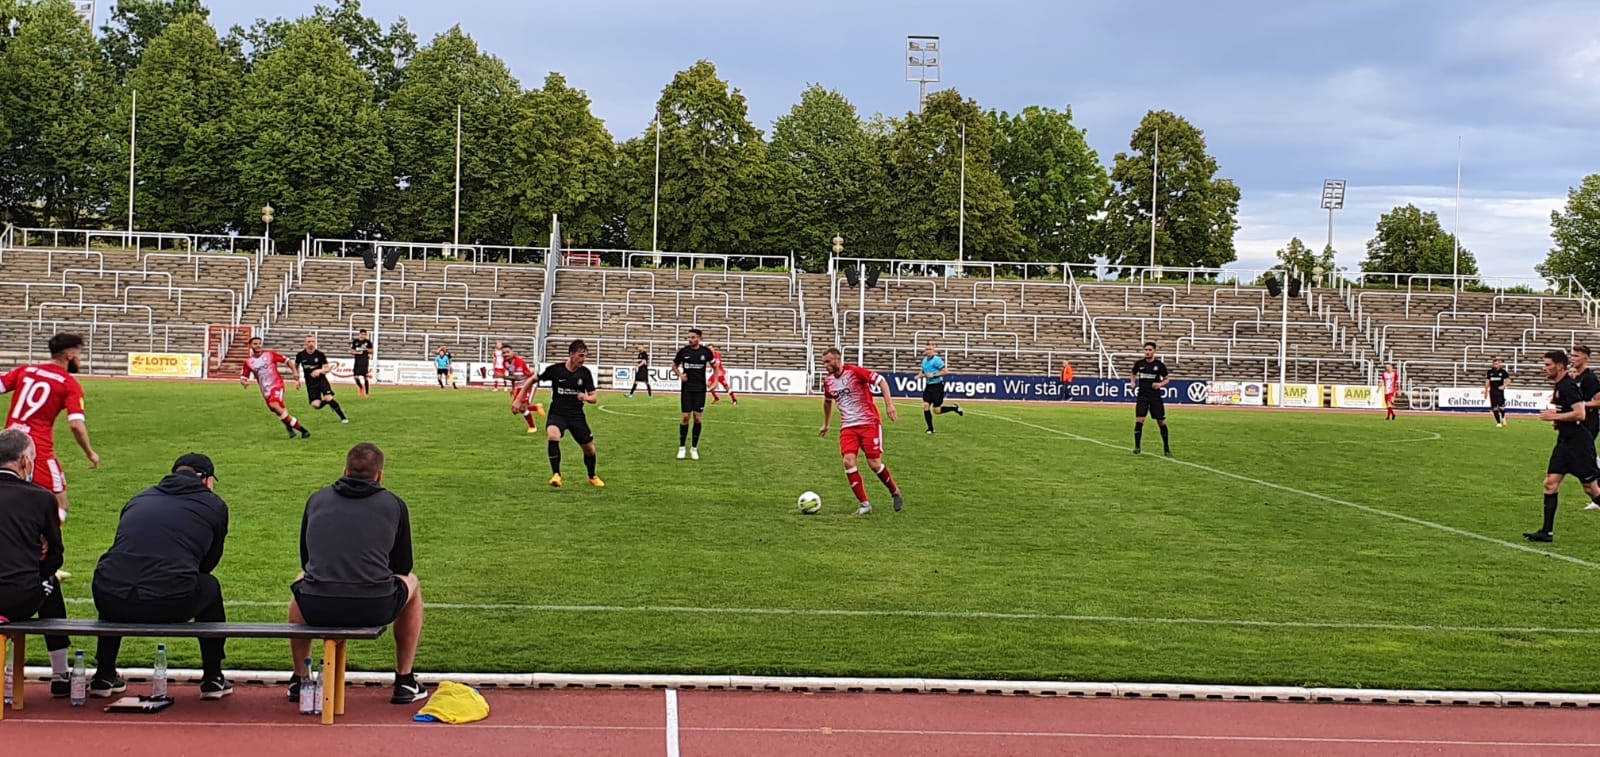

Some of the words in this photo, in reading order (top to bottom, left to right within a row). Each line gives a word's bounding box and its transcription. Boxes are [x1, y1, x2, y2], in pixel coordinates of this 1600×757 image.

[145, 357, 178, 366] LOTTO
[646, 368, 679, 382] RUG
[729, 370, 791, 392] nicke
[895, 377, 996, 396] Volwagen
[1003, 379, 1031, 395] Wir
[1034, 381, 1090, 396] stären
[1095, 383, 1119, 397] die
[1124, 384, 1177, 398] Reon
[1187, 382, 1208, 402] VW
[1344, 388, 1371, 400] AMP
[11, 376, 51, 421] 19
[1504, 398, 1538, 408] aldener
